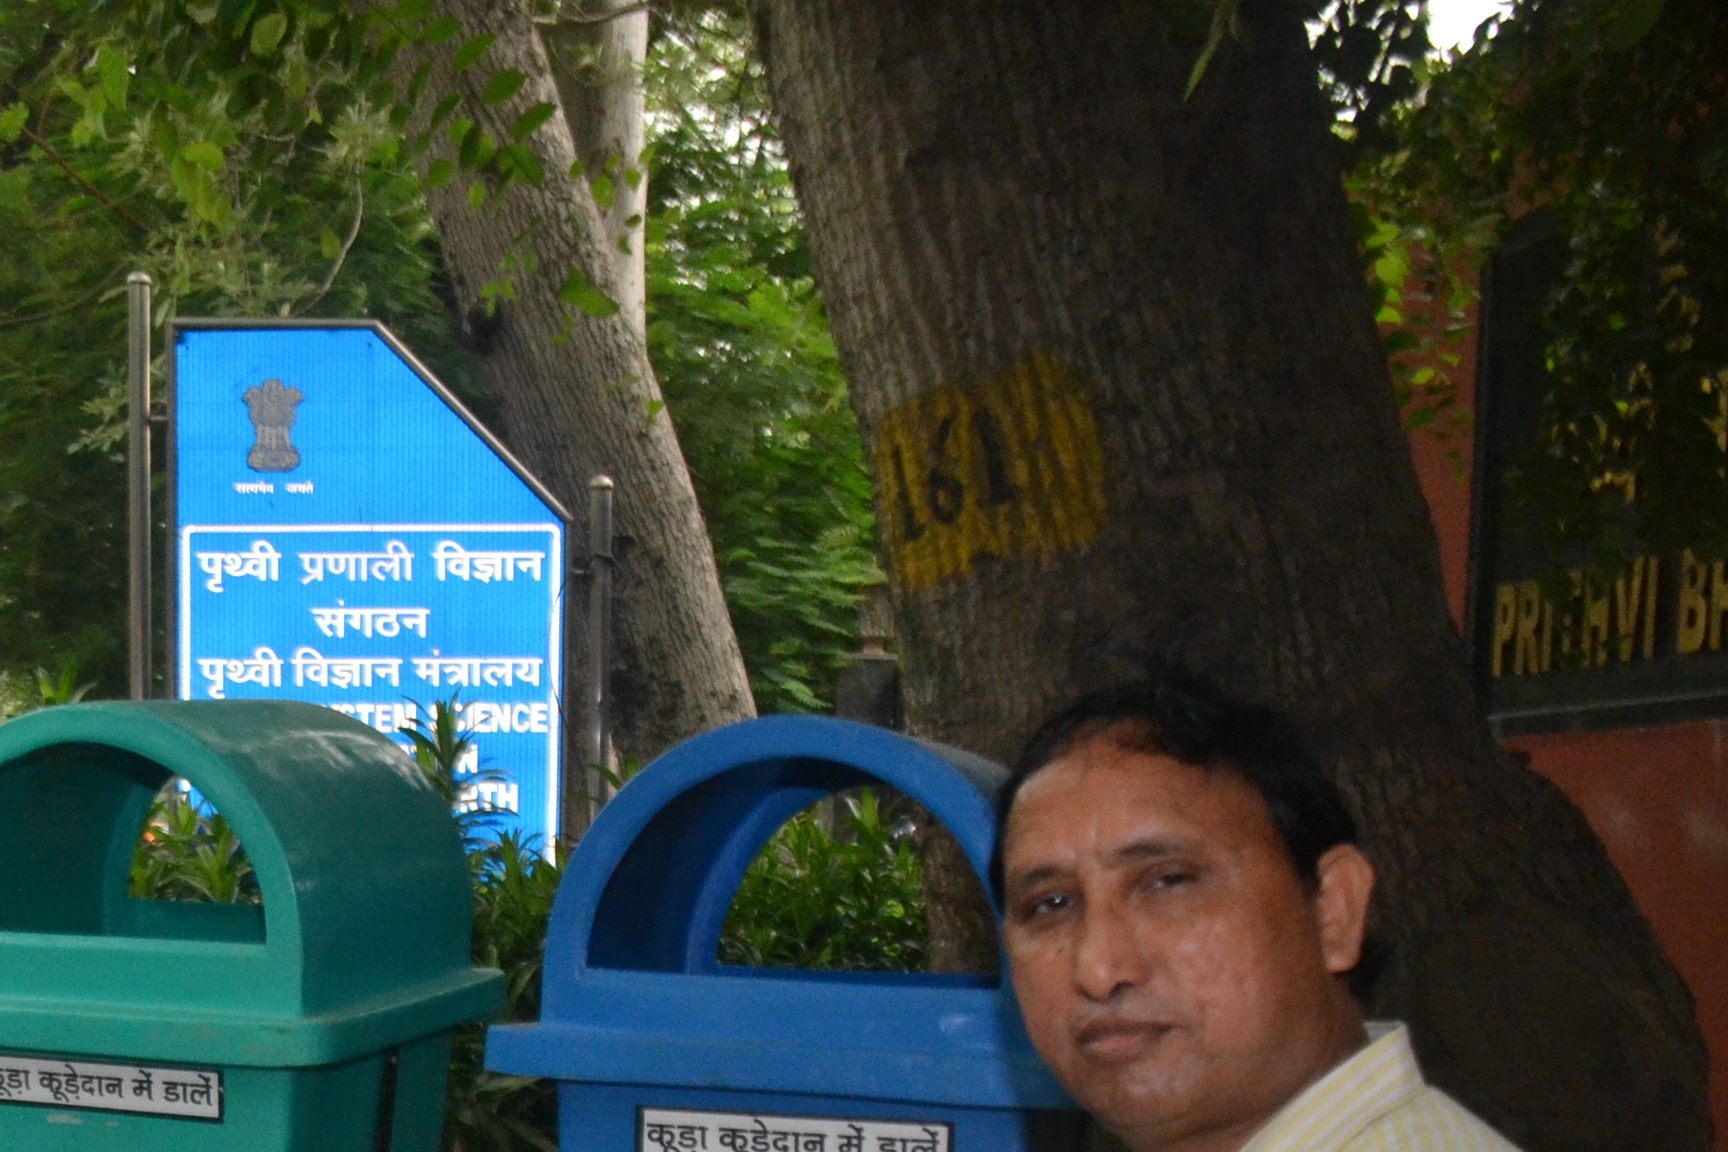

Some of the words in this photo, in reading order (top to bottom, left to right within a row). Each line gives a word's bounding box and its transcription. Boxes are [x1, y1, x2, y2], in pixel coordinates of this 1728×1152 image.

[197, 540, 281, 592] पृथ्वी
[299, 540, 414, 584] प्रणाली
[434, 540, 545, 582] विज्ञान
[313, 599, 430, 637] संगठन
[198, 647, 283, 699] पृथ्वी
[291, 647, 403, 688] विज्ञान
[413, 648, 543, 687] मंत्रालय
[38, 1064, 124, 1102] कूड़ेदान
[132, 1069, 153, 1101] में
[162, 1074, 213, 1107] डालें
